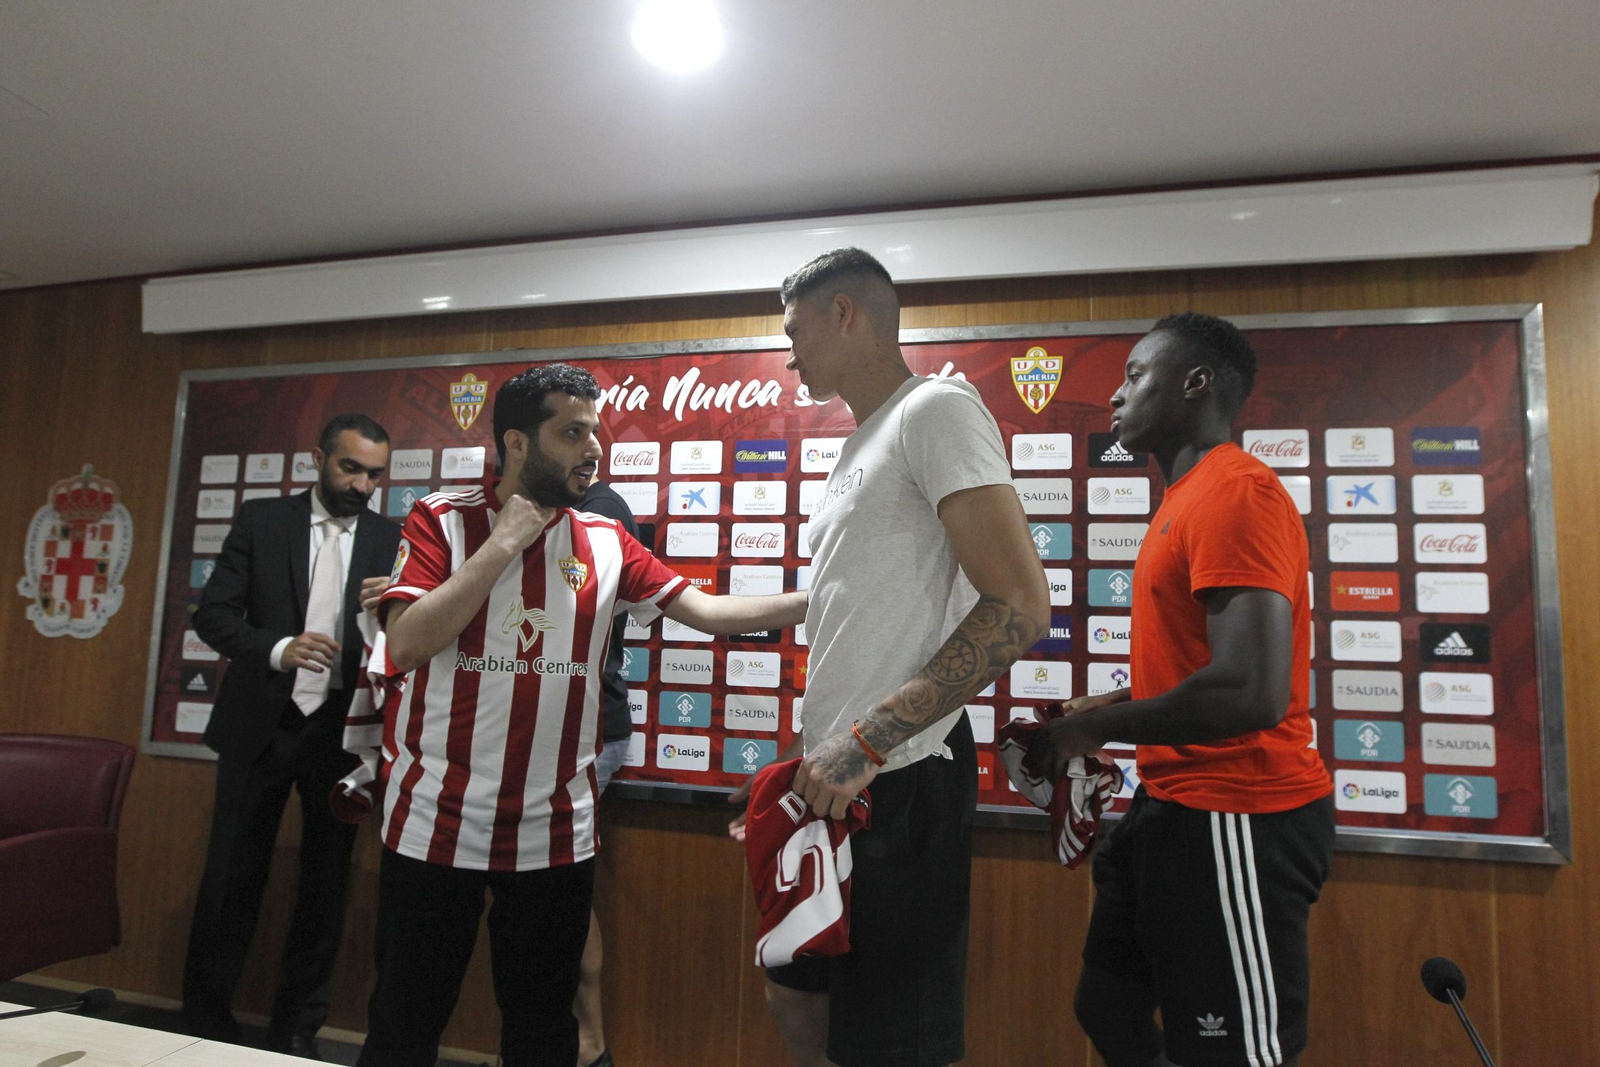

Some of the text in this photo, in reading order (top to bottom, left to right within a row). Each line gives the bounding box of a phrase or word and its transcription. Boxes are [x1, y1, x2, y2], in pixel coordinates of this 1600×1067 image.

[1017, 373, 1057, 382] ALMERIA
[597, 375, 650, 414] ría
[662, 366, 783, 422] Nunca
[1037, 443, 1055, 451] ASG
[1250, 439, 1306, 457] Coca-Cola
[1454, 439, 1480, 451] HILL
[613, 450, 657, 467] Coca-Cola
[767, 450, 787, 460] HILL
[1100, 453, 1134, 462] adidas
[398, 460, 431, 469] SAUDIA
[1023, 492, 1069, 501] SAUDIA
[1114, 488, 1133, 496] ASG
[734, 532, 781, 549] Coca-Cola
[1419, 534, 1480, 553] Coca-Cola
[1349, 586, 1394, 596] ESTRELLA
[1112, 595, 1127, 603] PDR
[1111, 631, 1131, 640] LaLi
[1360, 631, 1380, 640] ASG
[1434, 646, 1474, 656] adidas
[454, 652, 588, 676] Arabian Centres
[671, 662, 712, 673] SAUDIA
[747, 661, 764, 669] ASG
[1345, 686, 1399, 697] SAUDIA
[1451, 684, 1472, 693] ASG
[734, 708, 776, 720] SAUDIA
[1435, 739, 1491, 751] SAUDIA
[677, 747, 706, 759] LaLiga
[1360, 749, 1378, 757] PDR
[743, 763, 757, 771] PDR
[1362, 786, 1399, 799] LaLiga
[1452, 805, 1471, 813] PDR
